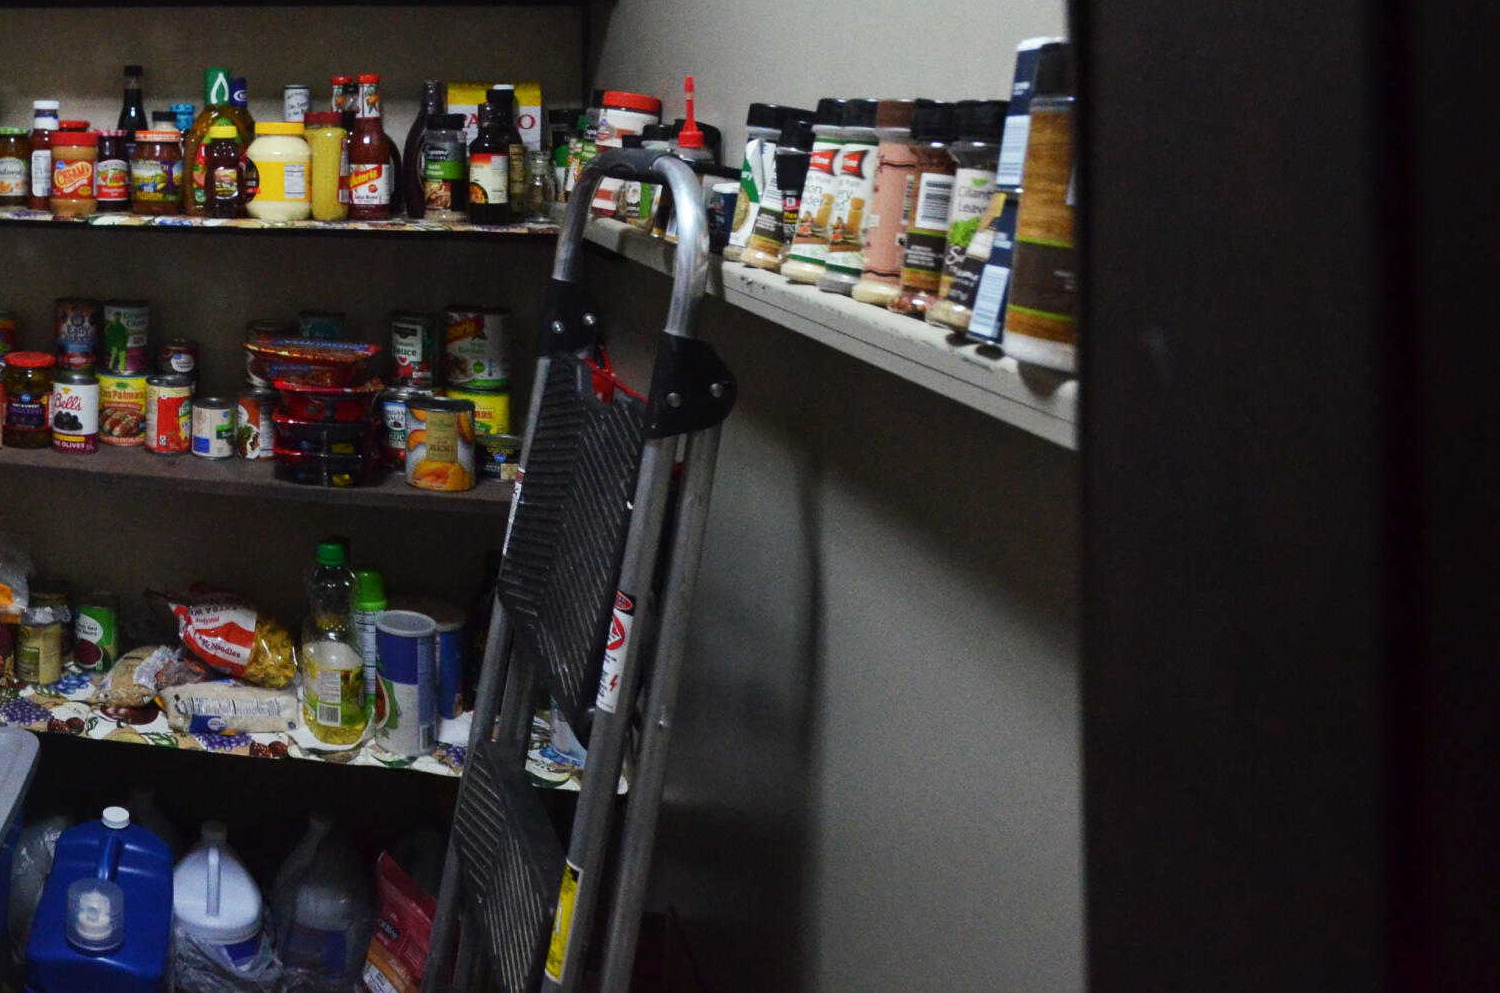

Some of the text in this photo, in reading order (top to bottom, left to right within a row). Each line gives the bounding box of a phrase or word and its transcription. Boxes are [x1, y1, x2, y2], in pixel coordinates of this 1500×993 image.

[56, 163, 91, 185] CREAMY
[62, 441, 85, 449] OLIVES
[211, 642, 242, 659] Noodles
